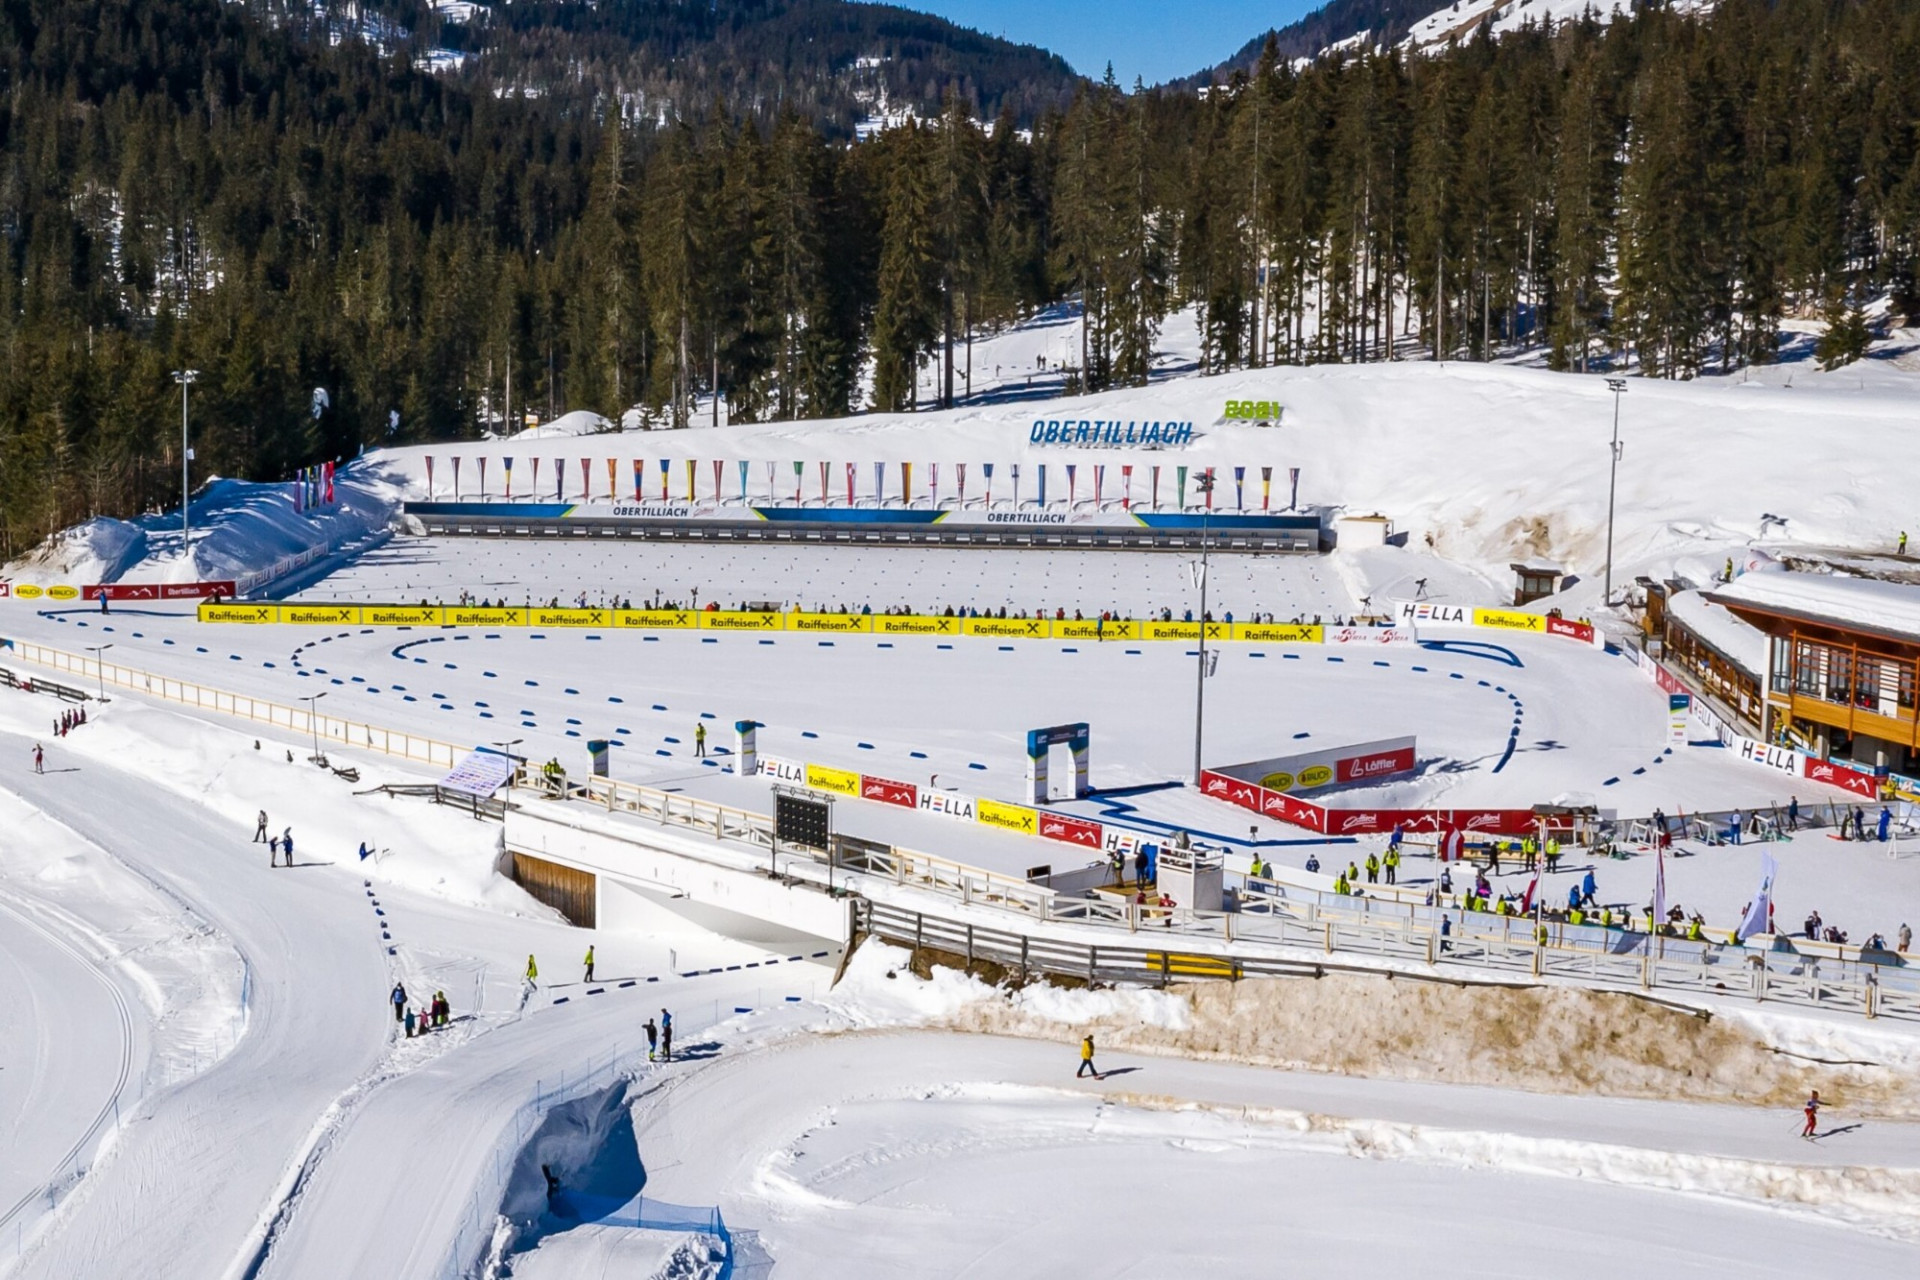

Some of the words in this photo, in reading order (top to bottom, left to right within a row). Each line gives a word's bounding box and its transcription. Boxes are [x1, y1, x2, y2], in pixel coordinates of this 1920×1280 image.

[1224, 400, 1280, 419] 2021
[1030, 420, 1193, 444] OBERTILLIACH
[613, 506, 689, 517] OBERTILLIACH
[987, 512, 1067, 523] OBERTILLIACH
[209, 611, 255, 621] Raiffeisen
[291, 612, 338, 622] Raiffeisen
[373, 613, 421, 623] Raiffeisen
[1402, 604, 1464, 622] HELLA
[456, 614, 504, 624] Raiffeisen
[540, 614, 588, 625] Raiffeisen
[625, 616, 673, 626] Raiffeisen
[710, 617, 760, 628] Raiffeisen
[797, 619, 847, 630] Raiffeisen
[1483, 616, 1526, 628] Raiffeisen
[885, 621, 936, 632] Raiffeisen
[974, 624, 1025, 635] Raiffeisen
[1063, 626, 1115, 637] Raiffeien
[1245, 629, 1297, 641] Raiffeisen
[1741, 740, 1796, 773] HELLA
[756, 759, 803, 783] HELLA
[1365, 759, 1397, 772] Löffler
[808, 775, 846, 792] Raiffeisen
[920, 793, 973, 819] HELLA
[979, 811, 1021, 829] Raiffeisen
